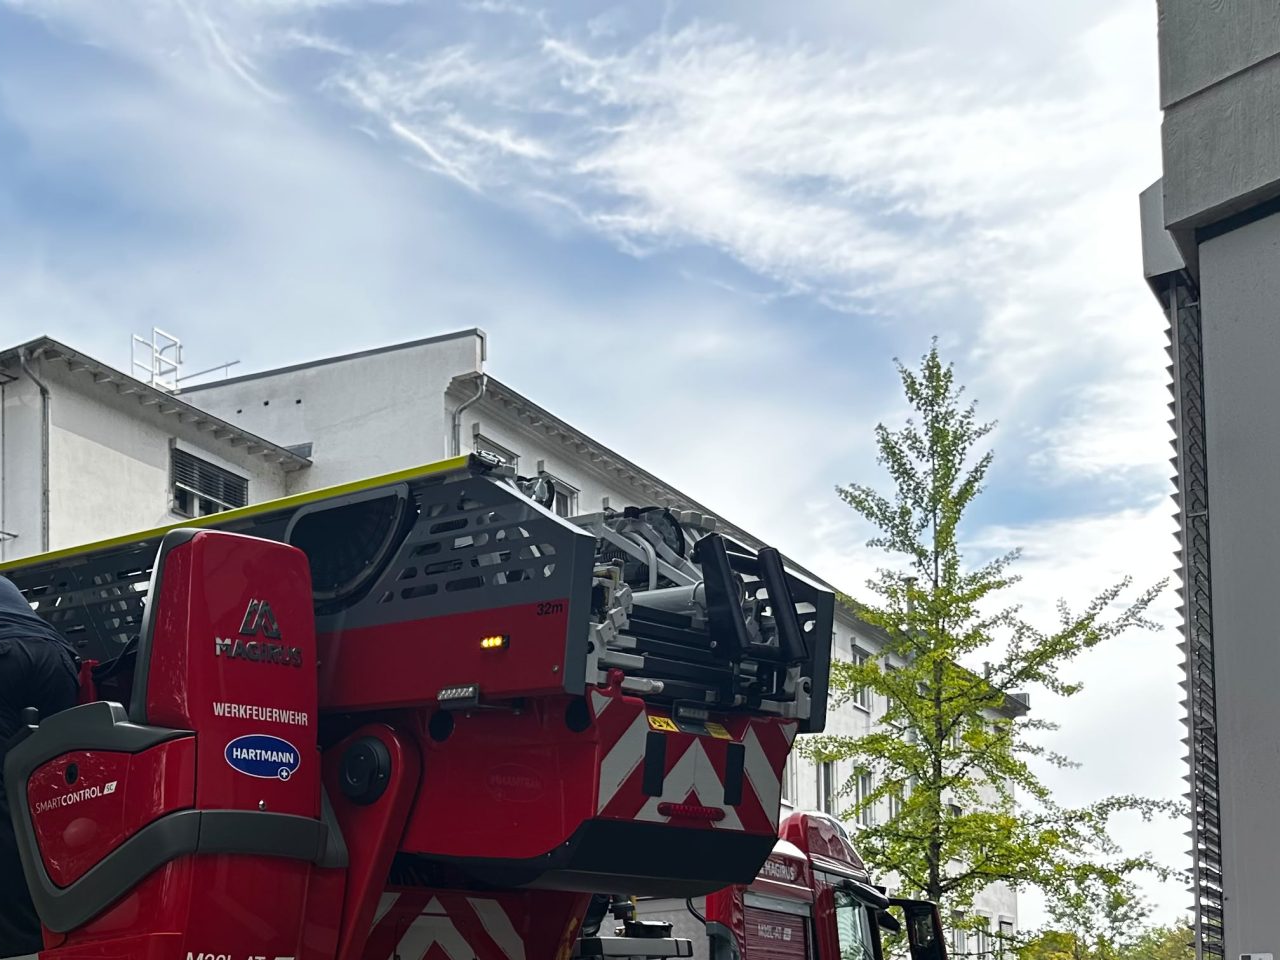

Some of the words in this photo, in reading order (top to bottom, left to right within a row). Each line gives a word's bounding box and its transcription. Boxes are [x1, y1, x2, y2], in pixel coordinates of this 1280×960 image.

[536, 602, 563, 616] 32m
[215, 636, 302, 668] MAGIRUS
[213, 702, 308, 726] WERKFEUERWEHR
[232, 747, 294, 764] HARTMANN
[35, 785, 102, 814] SMARTCONTROL
[106, 783, 113, 793] SC
